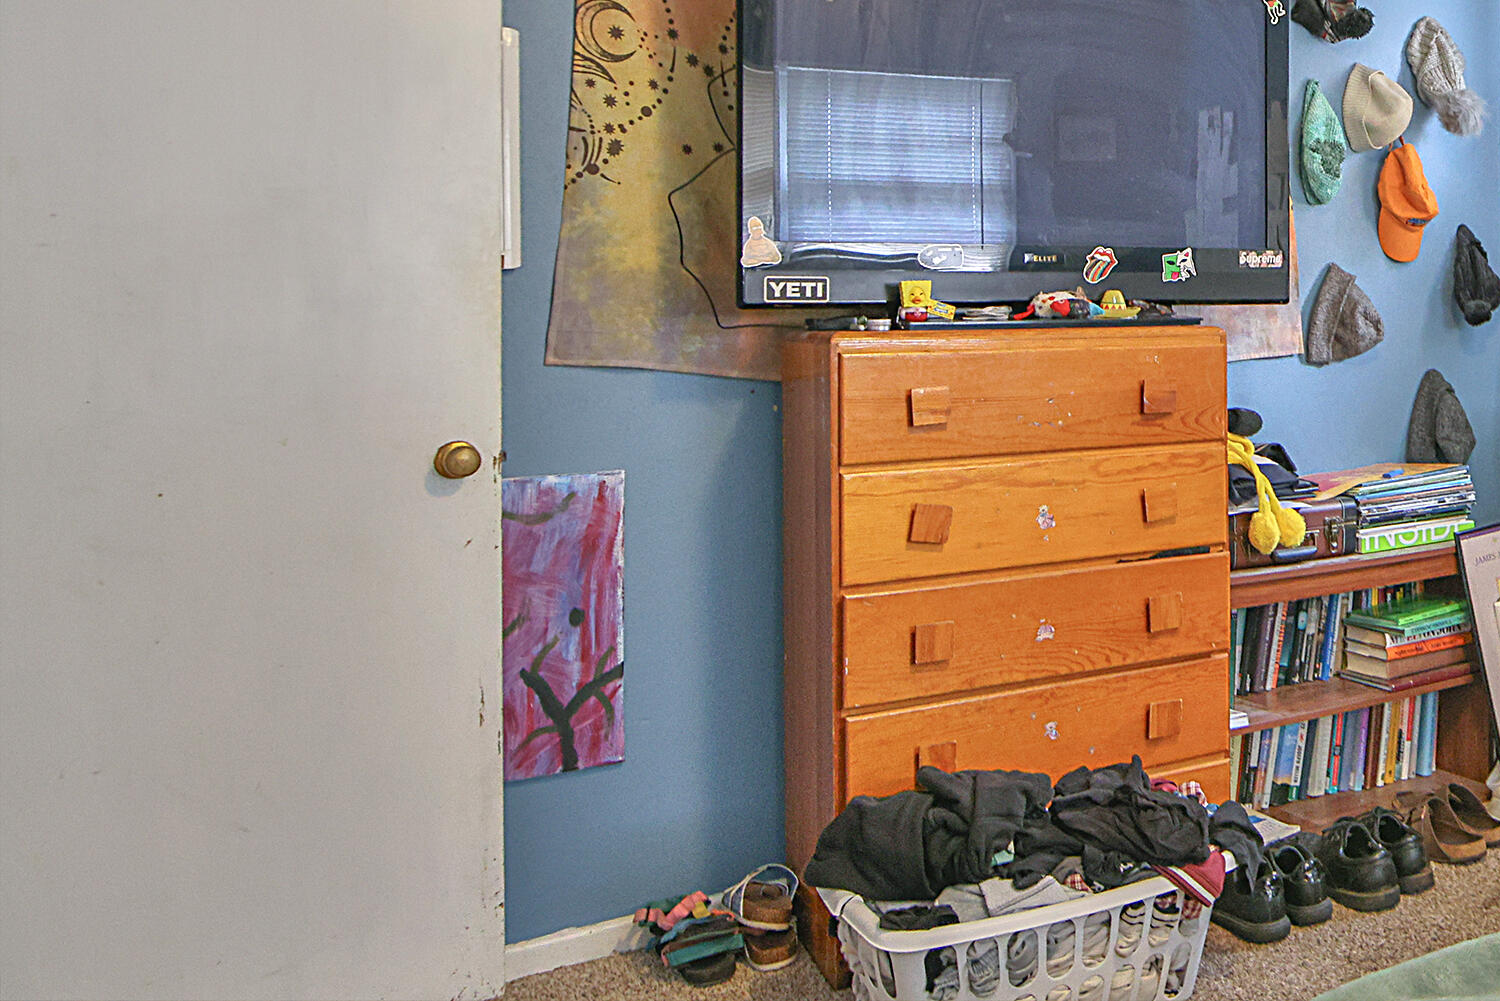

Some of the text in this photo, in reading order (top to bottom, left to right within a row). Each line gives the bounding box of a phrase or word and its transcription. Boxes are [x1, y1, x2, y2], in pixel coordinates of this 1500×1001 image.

[1240, 251, 1282, 267] Supreme
[769, 281, 823, 298] YETI
[1364, 522, 1459, 551] INSID
